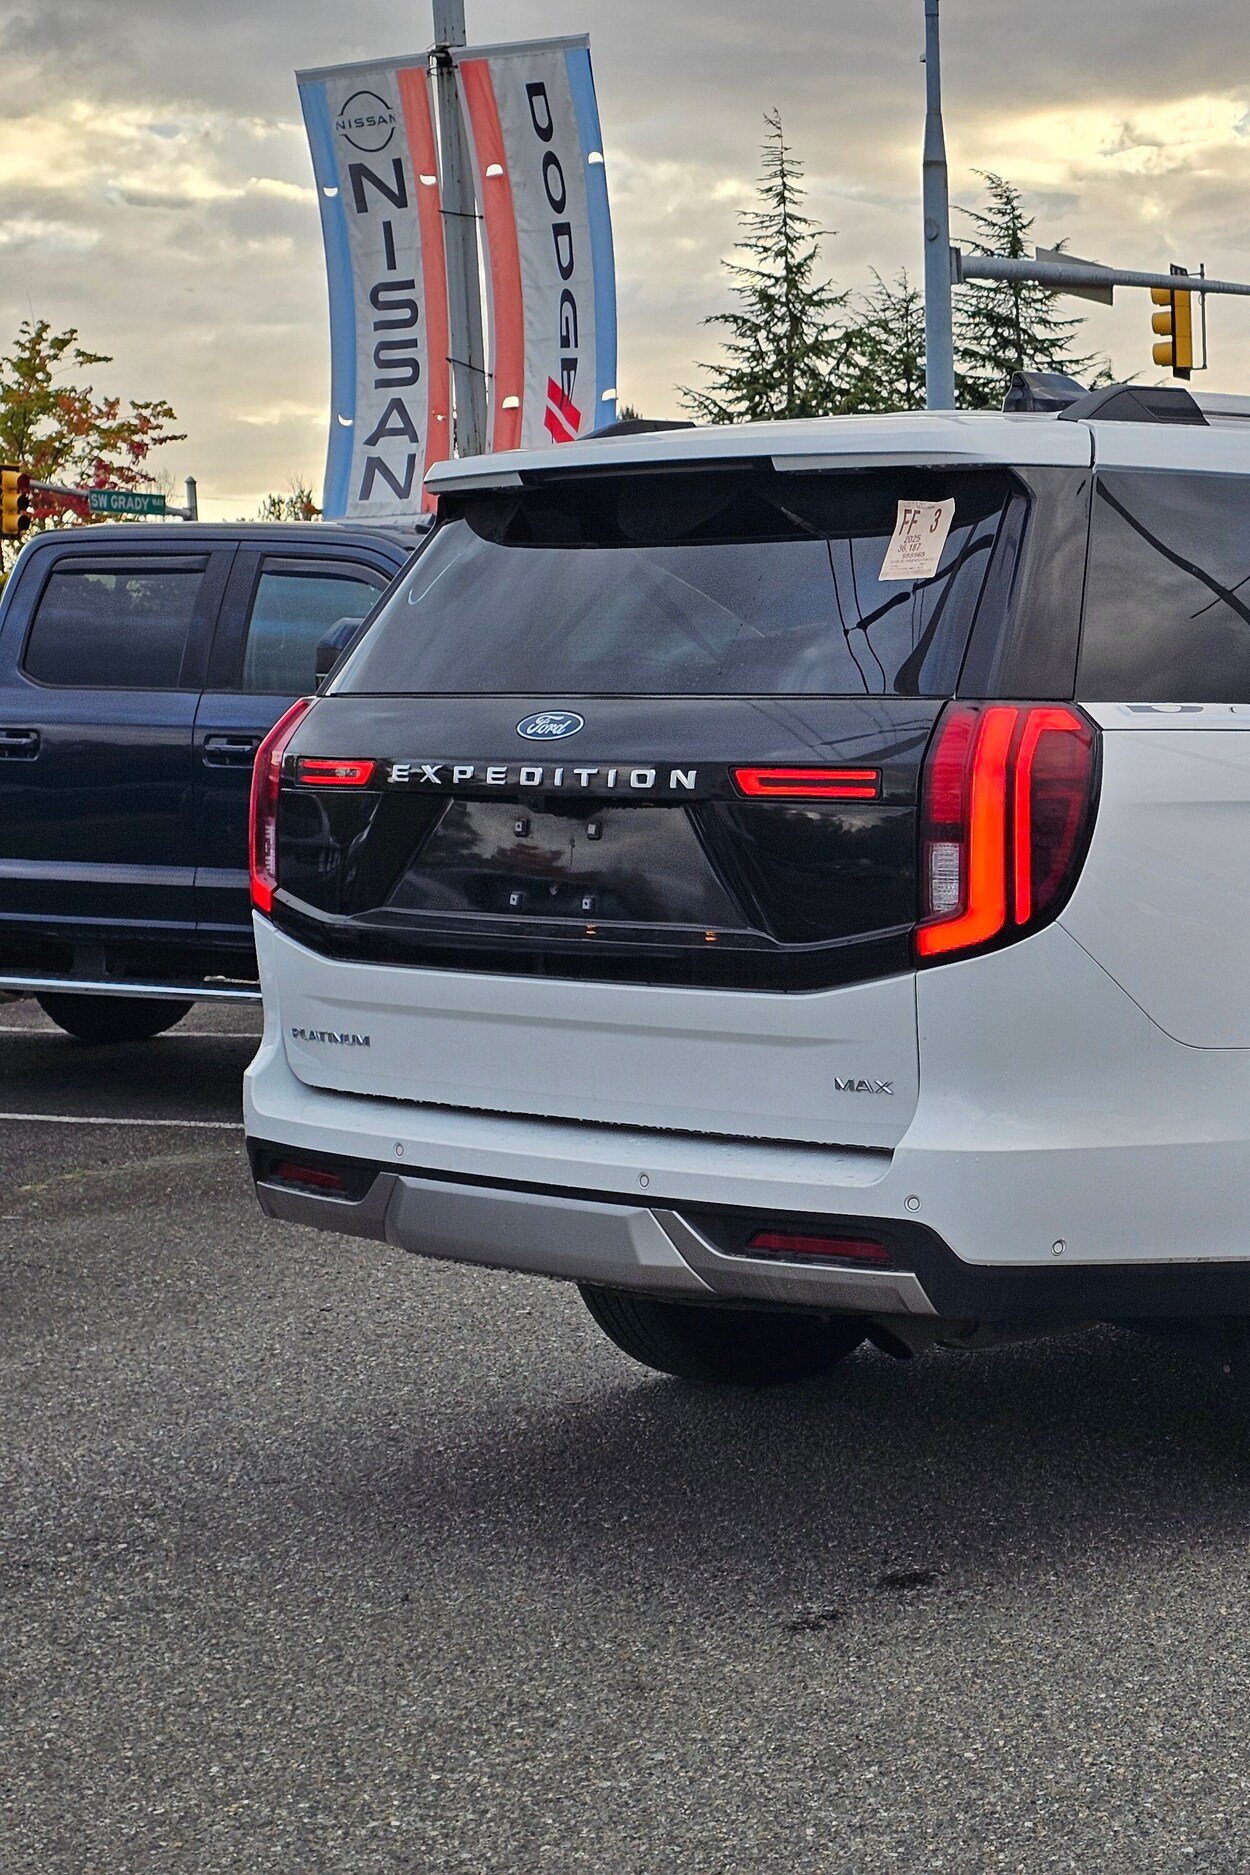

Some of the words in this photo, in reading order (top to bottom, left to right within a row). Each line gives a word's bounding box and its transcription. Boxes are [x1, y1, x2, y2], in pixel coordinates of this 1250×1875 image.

[336, 112, 396, 131] NISSAN
[525, 82, 579, 407] DODGE
[348, 157, 420, 501] NISSAN
[91, 493, 107, 508] SW
[111, 494, 149, 511] GRADY
[526, 714, 570, 735] Ford
[390, 763, 697, 790] EXPEDITION
[291, 1028, 370, 1047] PLATINUM
[834, 1077, 894, 1095] MAX
